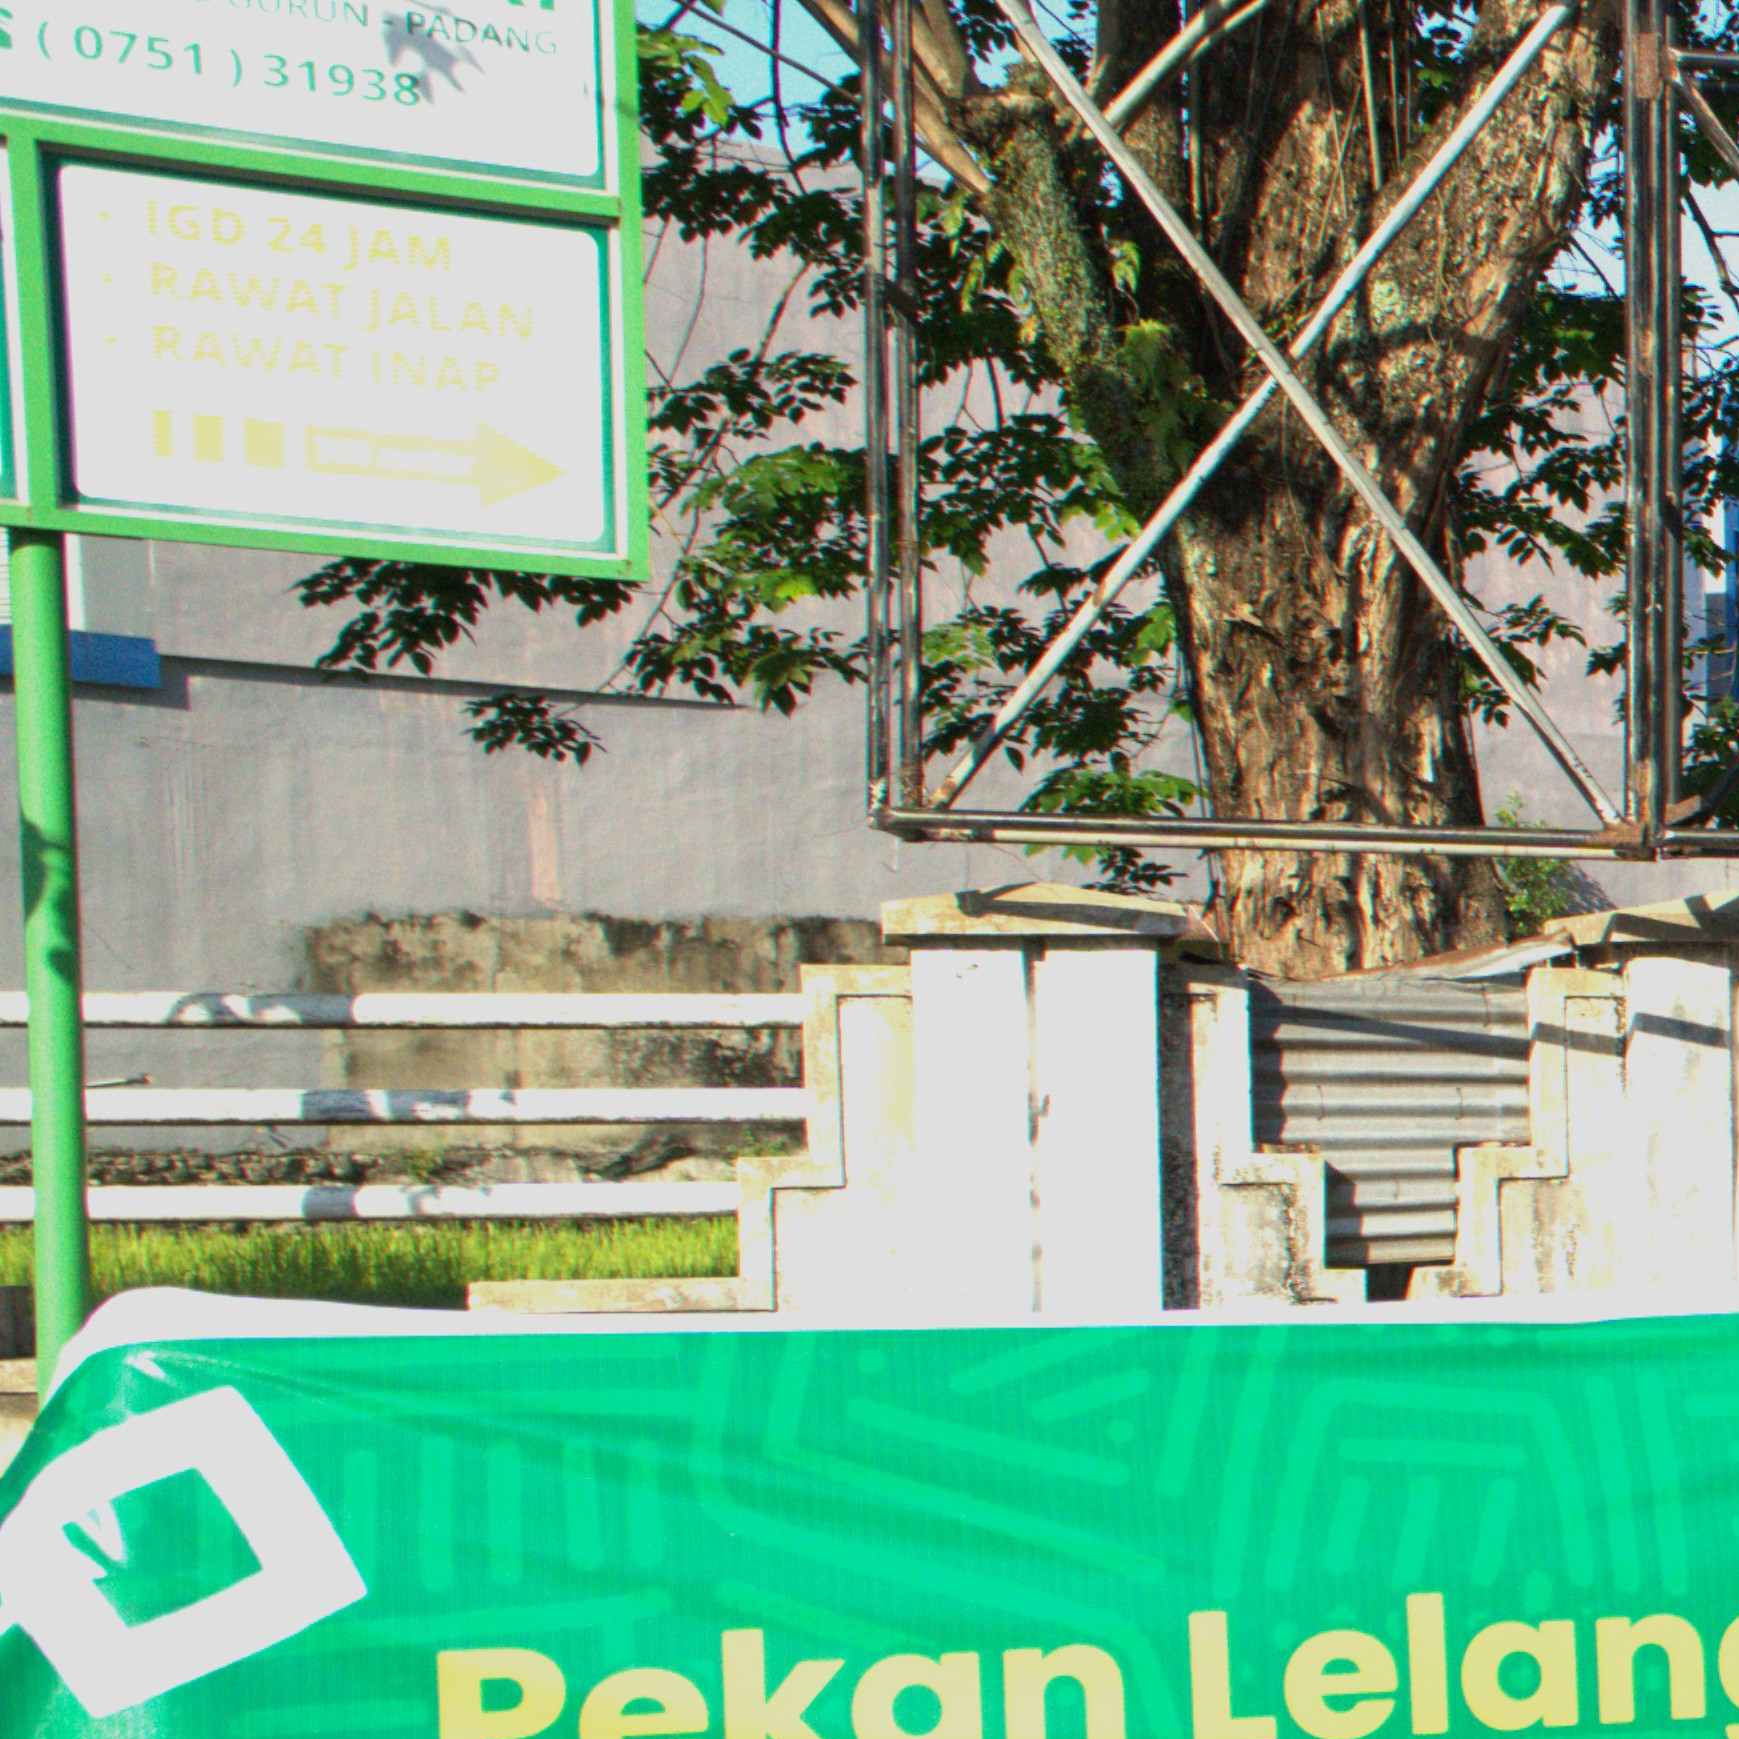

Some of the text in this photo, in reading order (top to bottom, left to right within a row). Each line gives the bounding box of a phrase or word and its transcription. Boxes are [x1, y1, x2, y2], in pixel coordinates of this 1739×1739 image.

[406, 11, 557, 54] PADANG
[263, 53, 420, 106] 31938
[146, 199, 452, 272] IGD 24 JAM
[149, 260, 535, 341] RAWAT JALAN
[151, 323, 501, 392] RAWAT INAP
